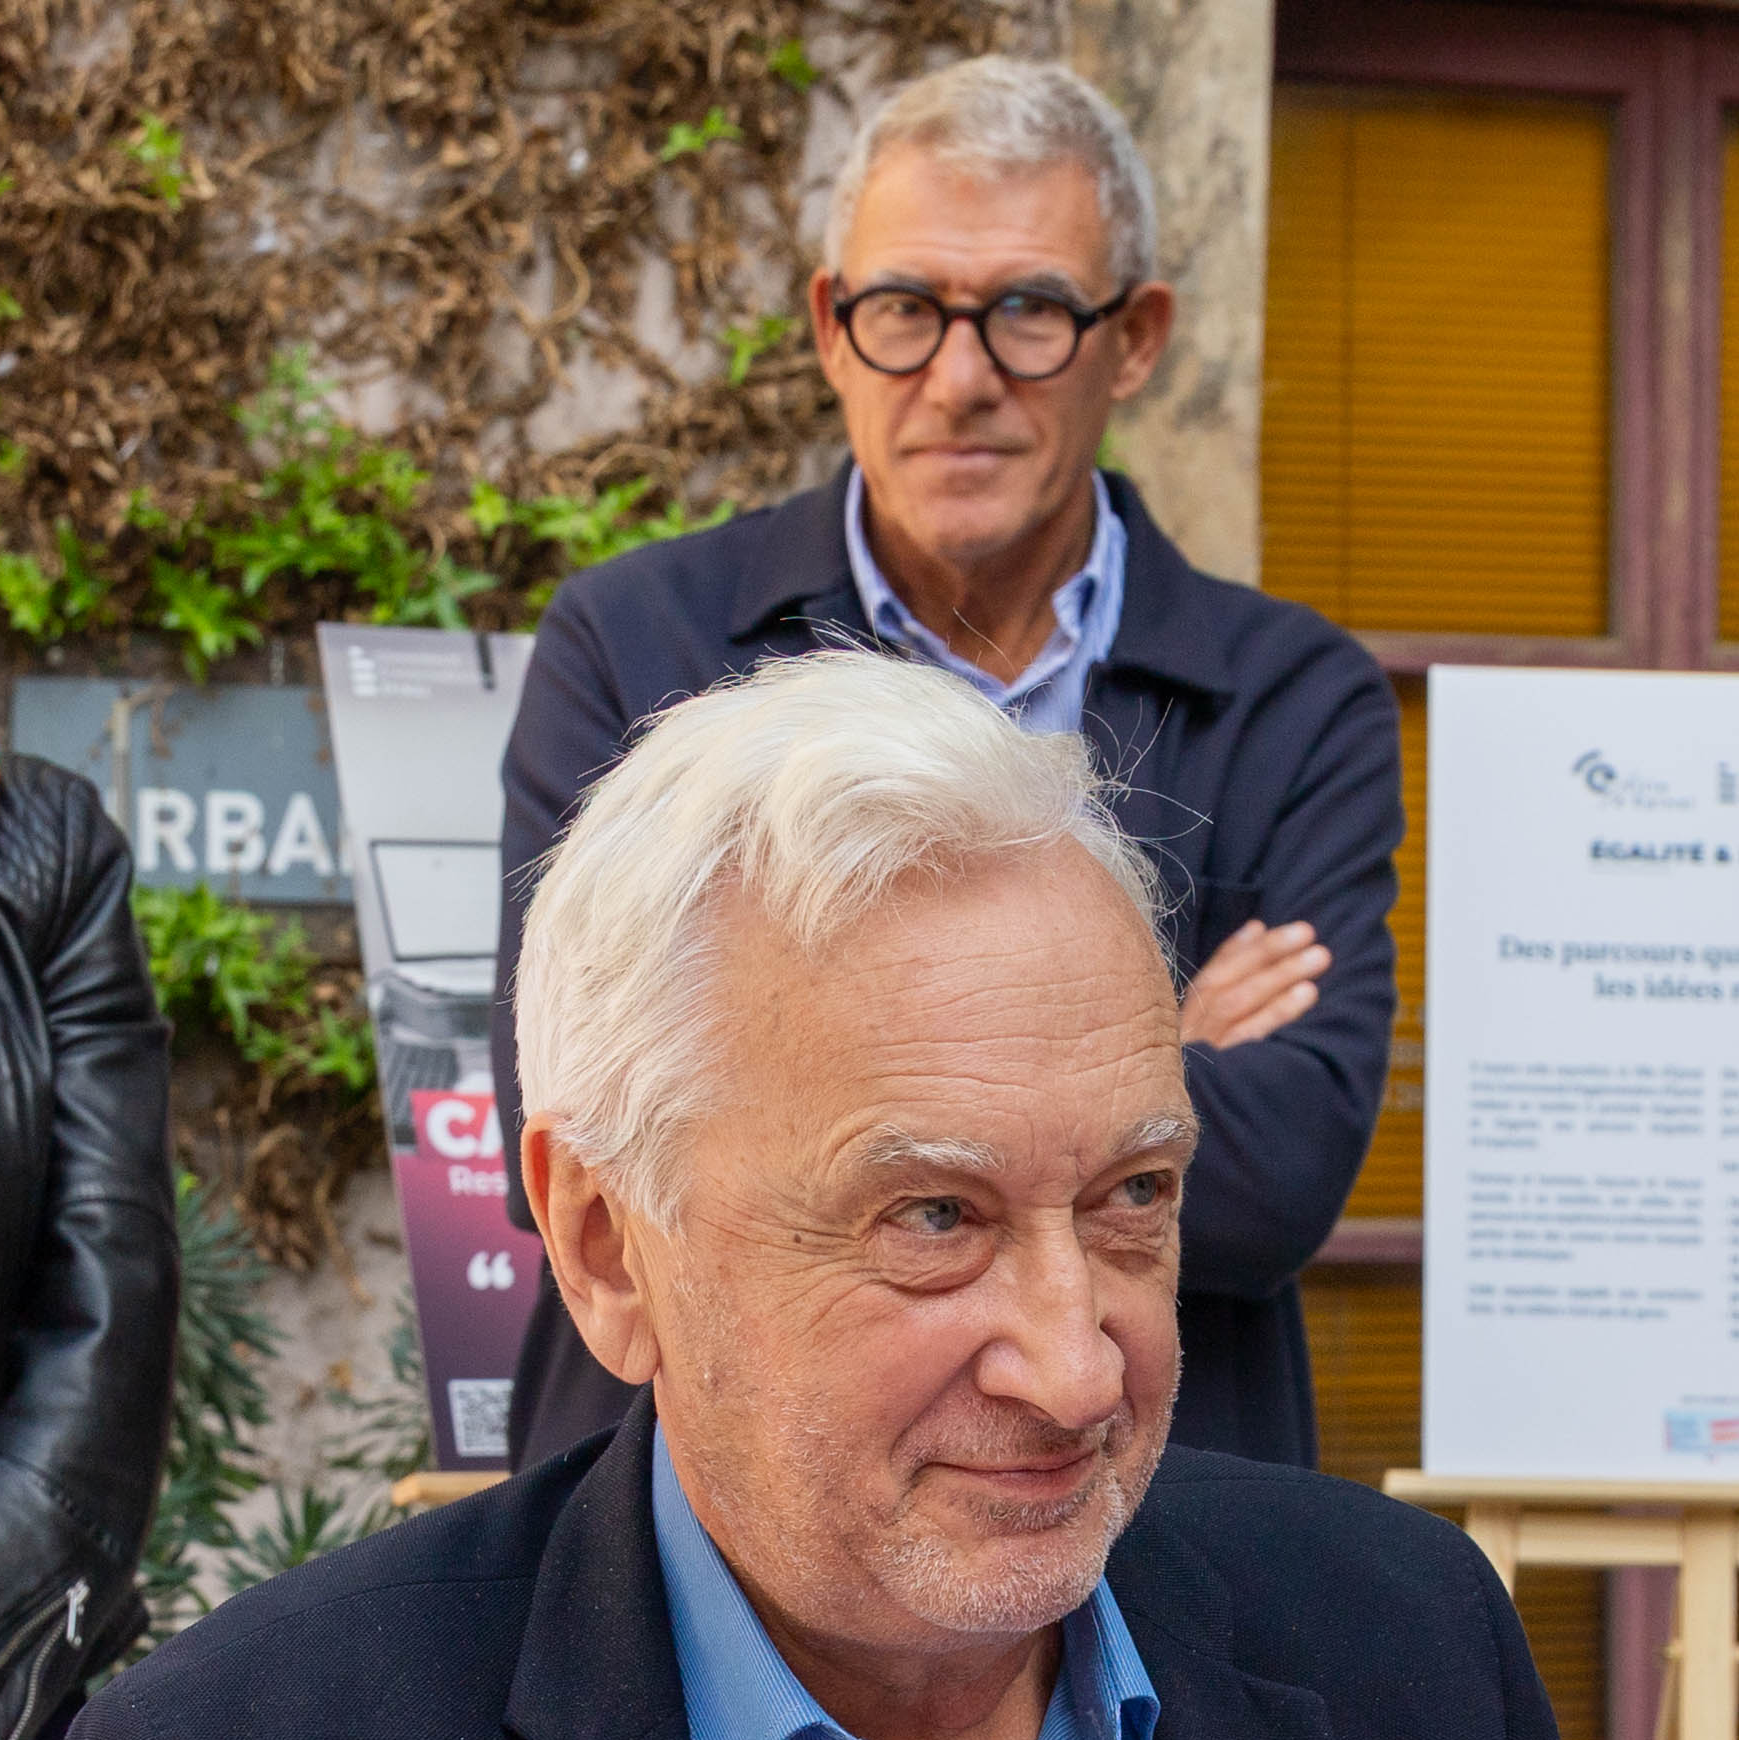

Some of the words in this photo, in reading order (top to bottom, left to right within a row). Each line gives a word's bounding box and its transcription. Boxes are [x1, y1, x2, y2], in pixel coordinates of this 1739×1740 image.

[1499, 933, 1555, 962] Des
[1561, 937, 1696, 970] parcours
[1594, 972, 1637, 998] les
